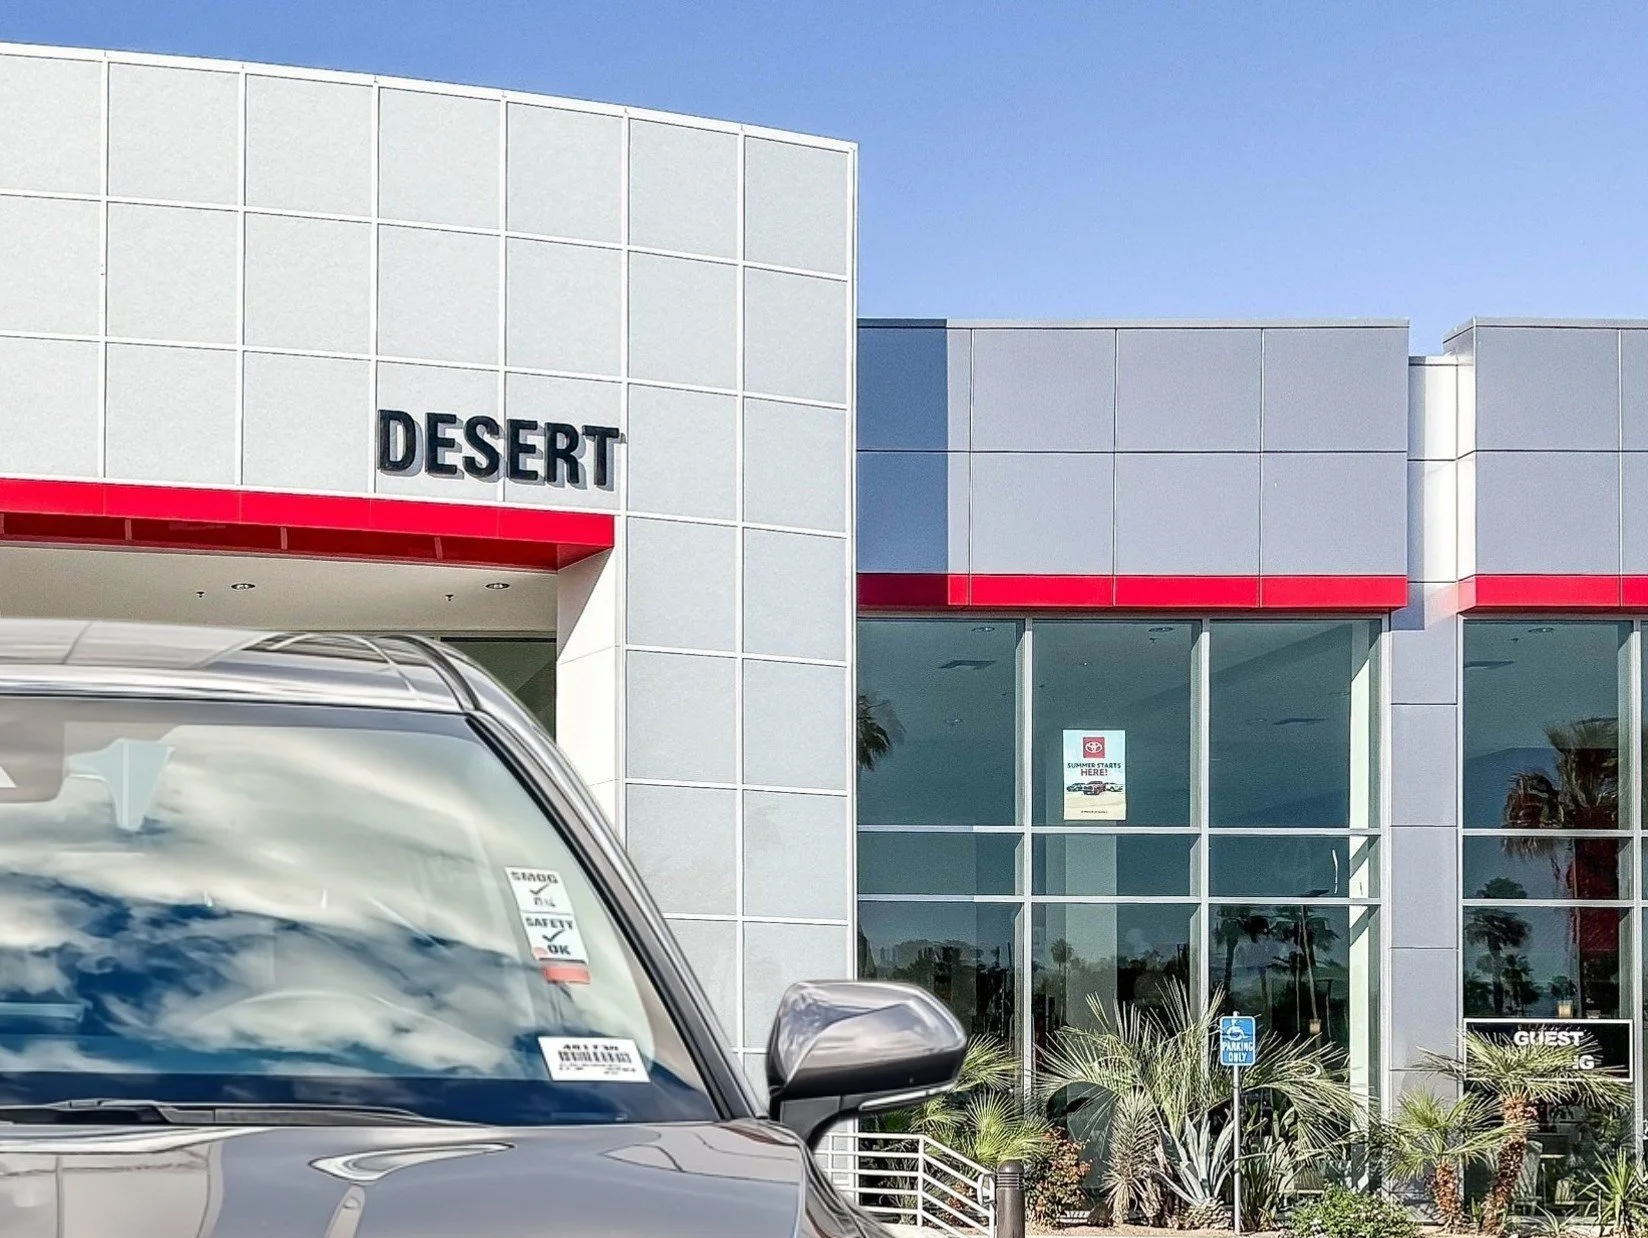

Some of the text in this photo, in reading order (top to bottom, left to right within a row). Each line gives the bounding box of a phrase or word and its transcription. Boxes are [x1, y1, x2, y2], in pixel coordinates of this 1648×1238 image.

[377, 409, 621, 486] DESERT
[1080, 768, 1108, 777] HERE!
[525, 917, 574, 930] SAFETY
[547, 944, 571, 955] OK
[1513, 1030, 1585, 1047] GUEST
[1221, 1041, 1254, 1052] PARKING
[1228, 1052, 1248, 1062] ONLY
